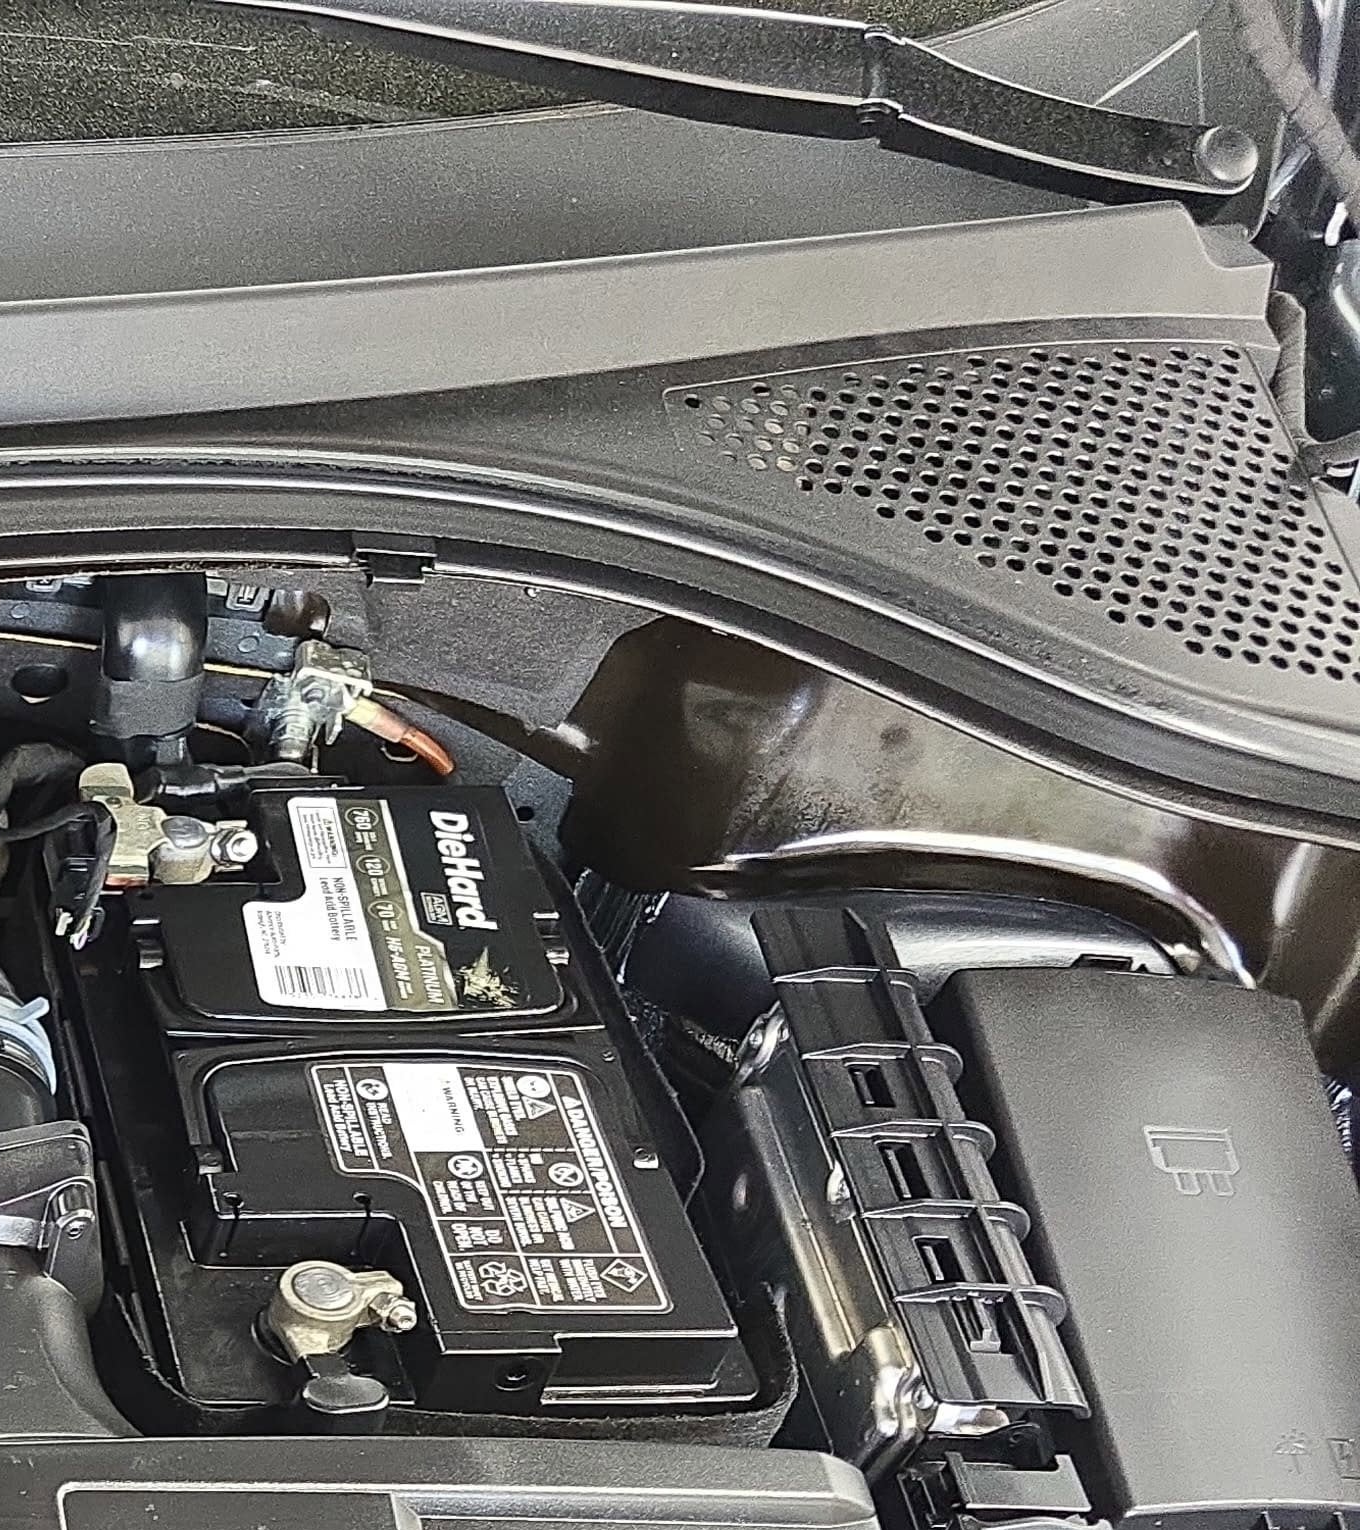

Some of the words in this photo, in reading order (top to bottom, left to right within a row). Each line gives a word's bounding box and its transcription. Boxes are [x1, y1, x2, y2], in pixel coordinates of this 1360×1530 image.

[352, 809, 372, 831] 760
[364, 858, 384, 876] 120
[430, 811, 499, 930] DieHard
[325, 897, 337, 911] Acid
[333, 877, 358, 941] NON-SPILLABLE
[376, 903, 396, 919] 70
[431, 896, 450, 925] AGM
[328, 912, 341, 941] Battery
[415, 945, 446, 1004] PLATINUM
[323, 1083, 340, 1104] Lead
[329, 1103, 345, 1123] Acid
[333, 1080, 369, 1157] NON-SPILLABLE
[377, 1102, 393, 1125] READ
[335, 1123, 353, 1153] Battery
[365, 1102, 393, 1159] INSTRUCTIONS.
[566, 1108, 629, 1228] DANGER/POISON
[451, 1223, 474, 1251] OPEN.
[468, 1226, 489, 1246] NOT
[484, 1229, 503, 1244] DO
